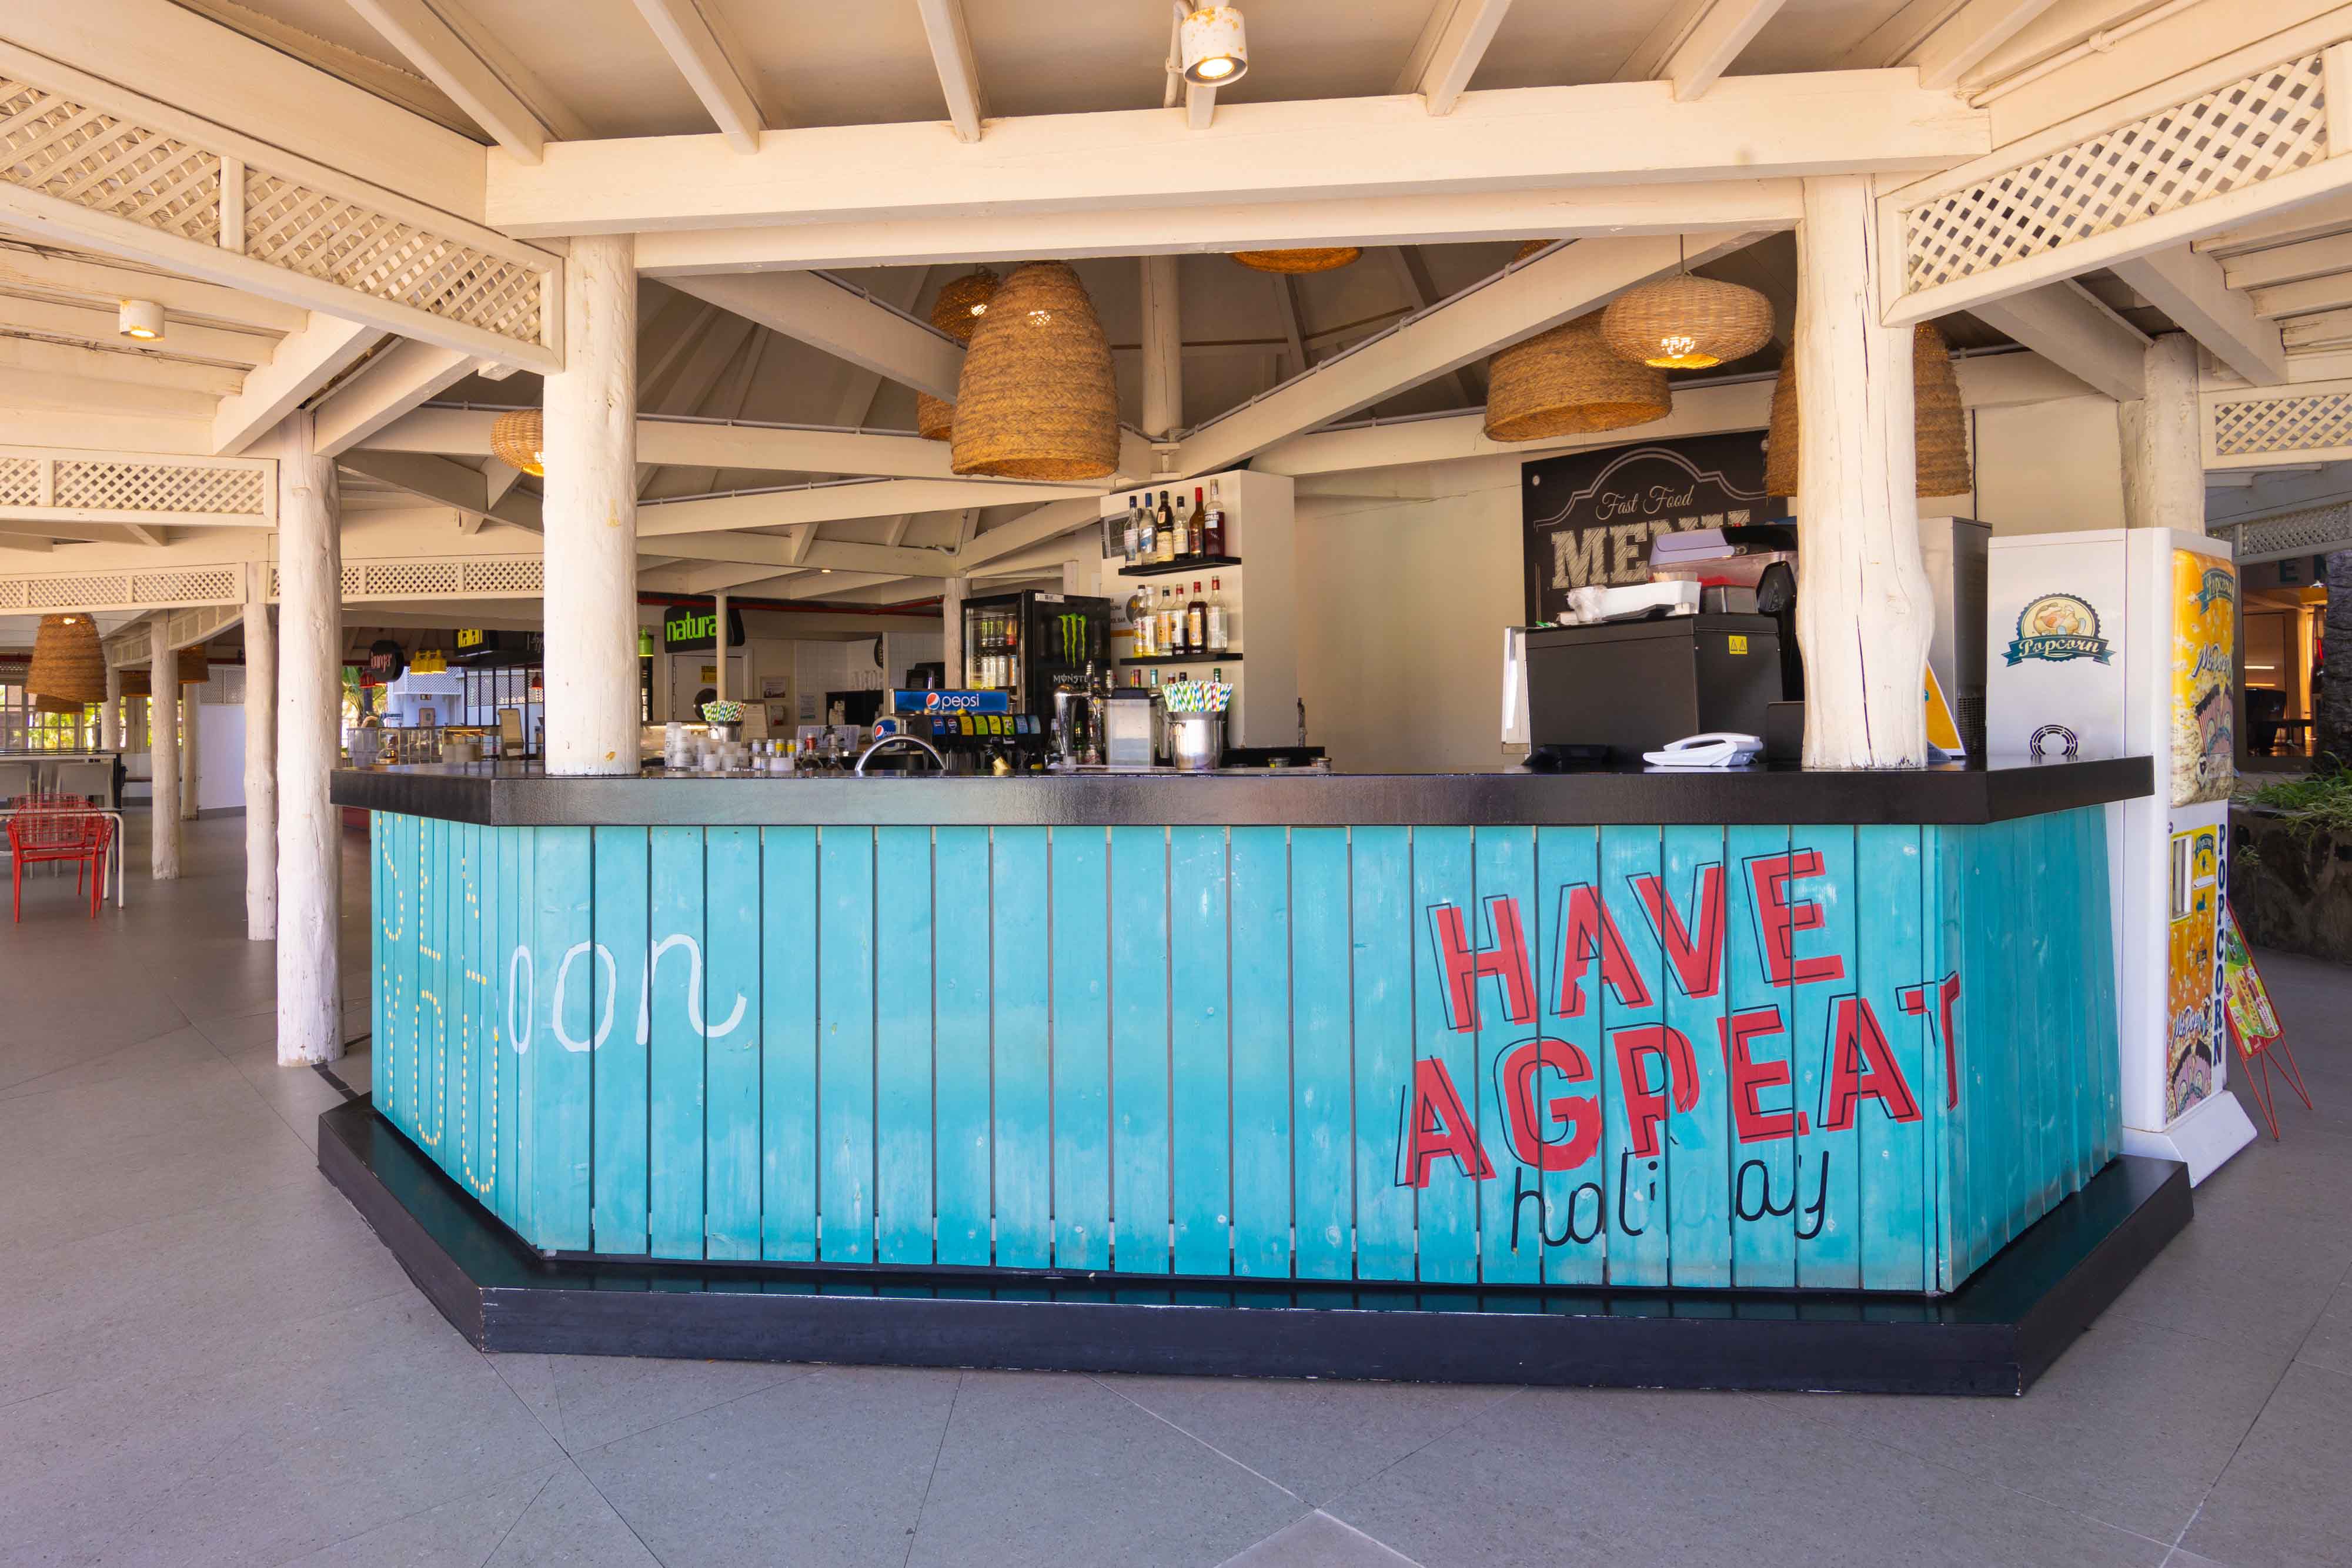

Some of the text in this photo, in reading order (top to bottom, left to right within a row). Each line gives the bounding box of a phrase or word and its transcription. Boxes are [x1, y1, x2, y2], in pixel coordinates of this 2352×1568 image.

[1596, 484, 1695, 520] Fast Food
[1551, 510, 1750, 589] ME
[666, 611, 717, 642] natura
[2018, 637, 2099, 658] Popcorn
[1053, 673, 1088, 684] MONST
[942, 693, 979, 710] pepsi
[1426, 847, 1845, 1034] HAVE
[2213, 824, 2226, 1066] POPCORN
[1511, 1150, 1829, 1256] holiay
